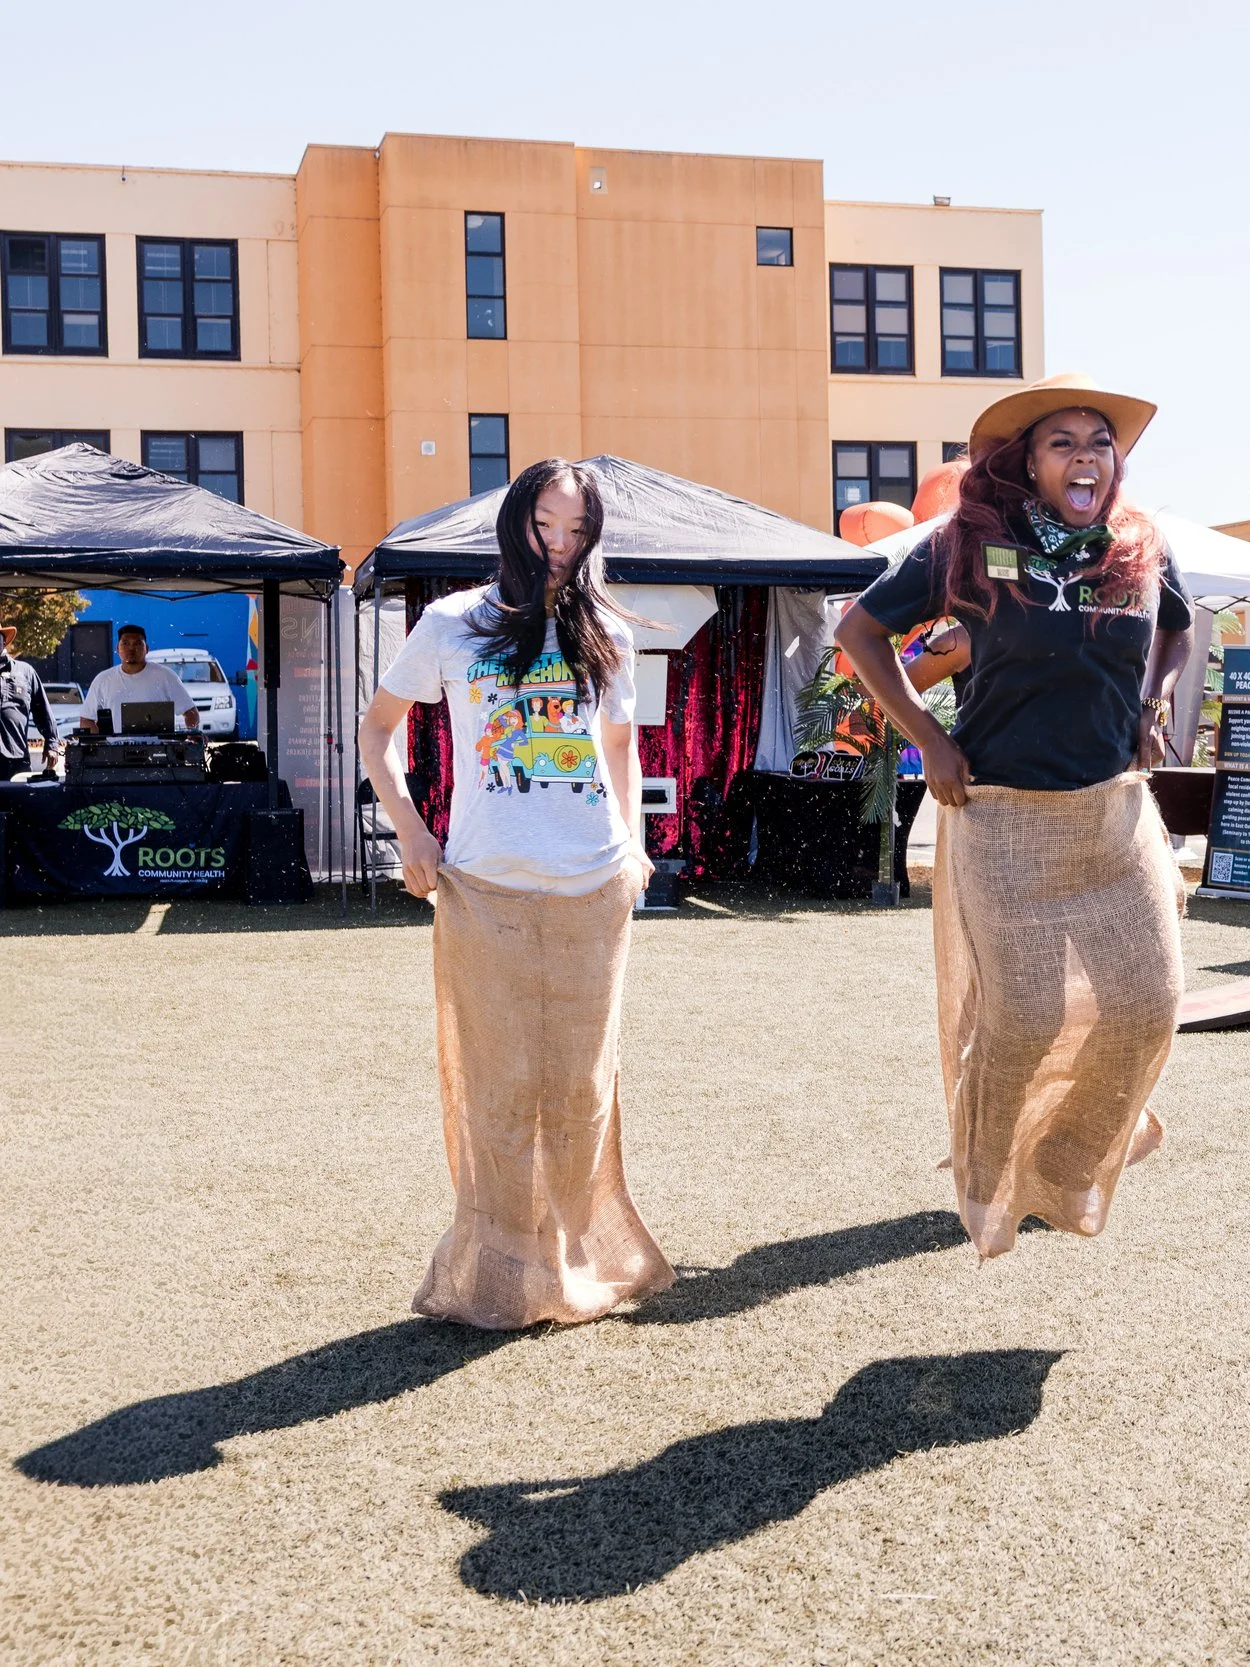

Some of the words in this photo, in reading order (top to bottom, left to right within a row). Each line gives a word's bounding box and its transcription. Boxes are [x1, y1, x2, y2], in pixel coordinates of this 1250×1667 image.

[1079, 586, 1150, 608] ROOT
[1229, 672, 1237, 680] 40
[138, 847, 225, 868] ROOTS
